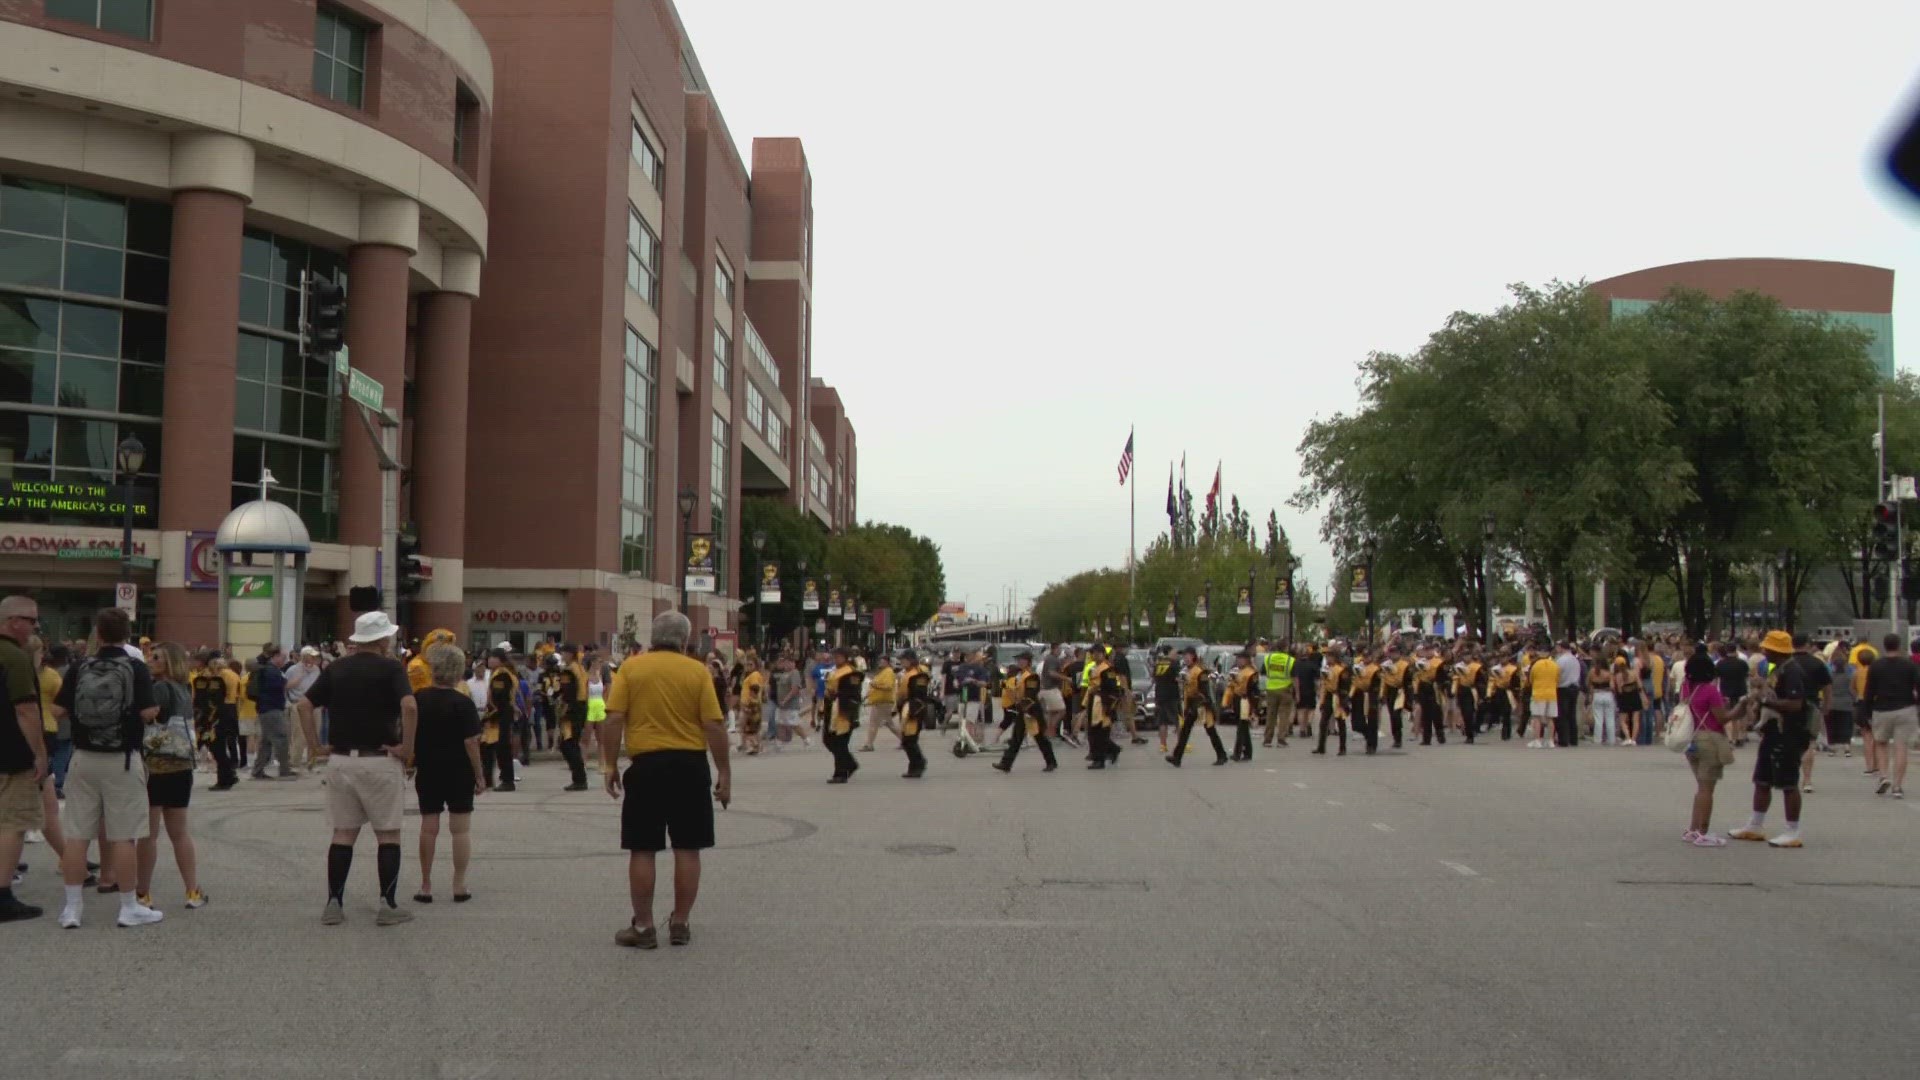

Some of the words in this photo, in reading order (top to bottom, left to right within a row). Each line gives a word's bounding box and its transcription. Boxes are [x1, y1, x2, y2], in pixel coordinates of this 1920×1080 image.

[350, 373, 382, 408] Broadway
[12, 482, 65, 494] WELCOME
[68, 484, 83, 495] TO
[87, 485, 106, 497] THE
[8, 497, 22, 508] AT
[27, 498, 47, 509] THE
[51, 500, 105, 512] AMERICA'S
